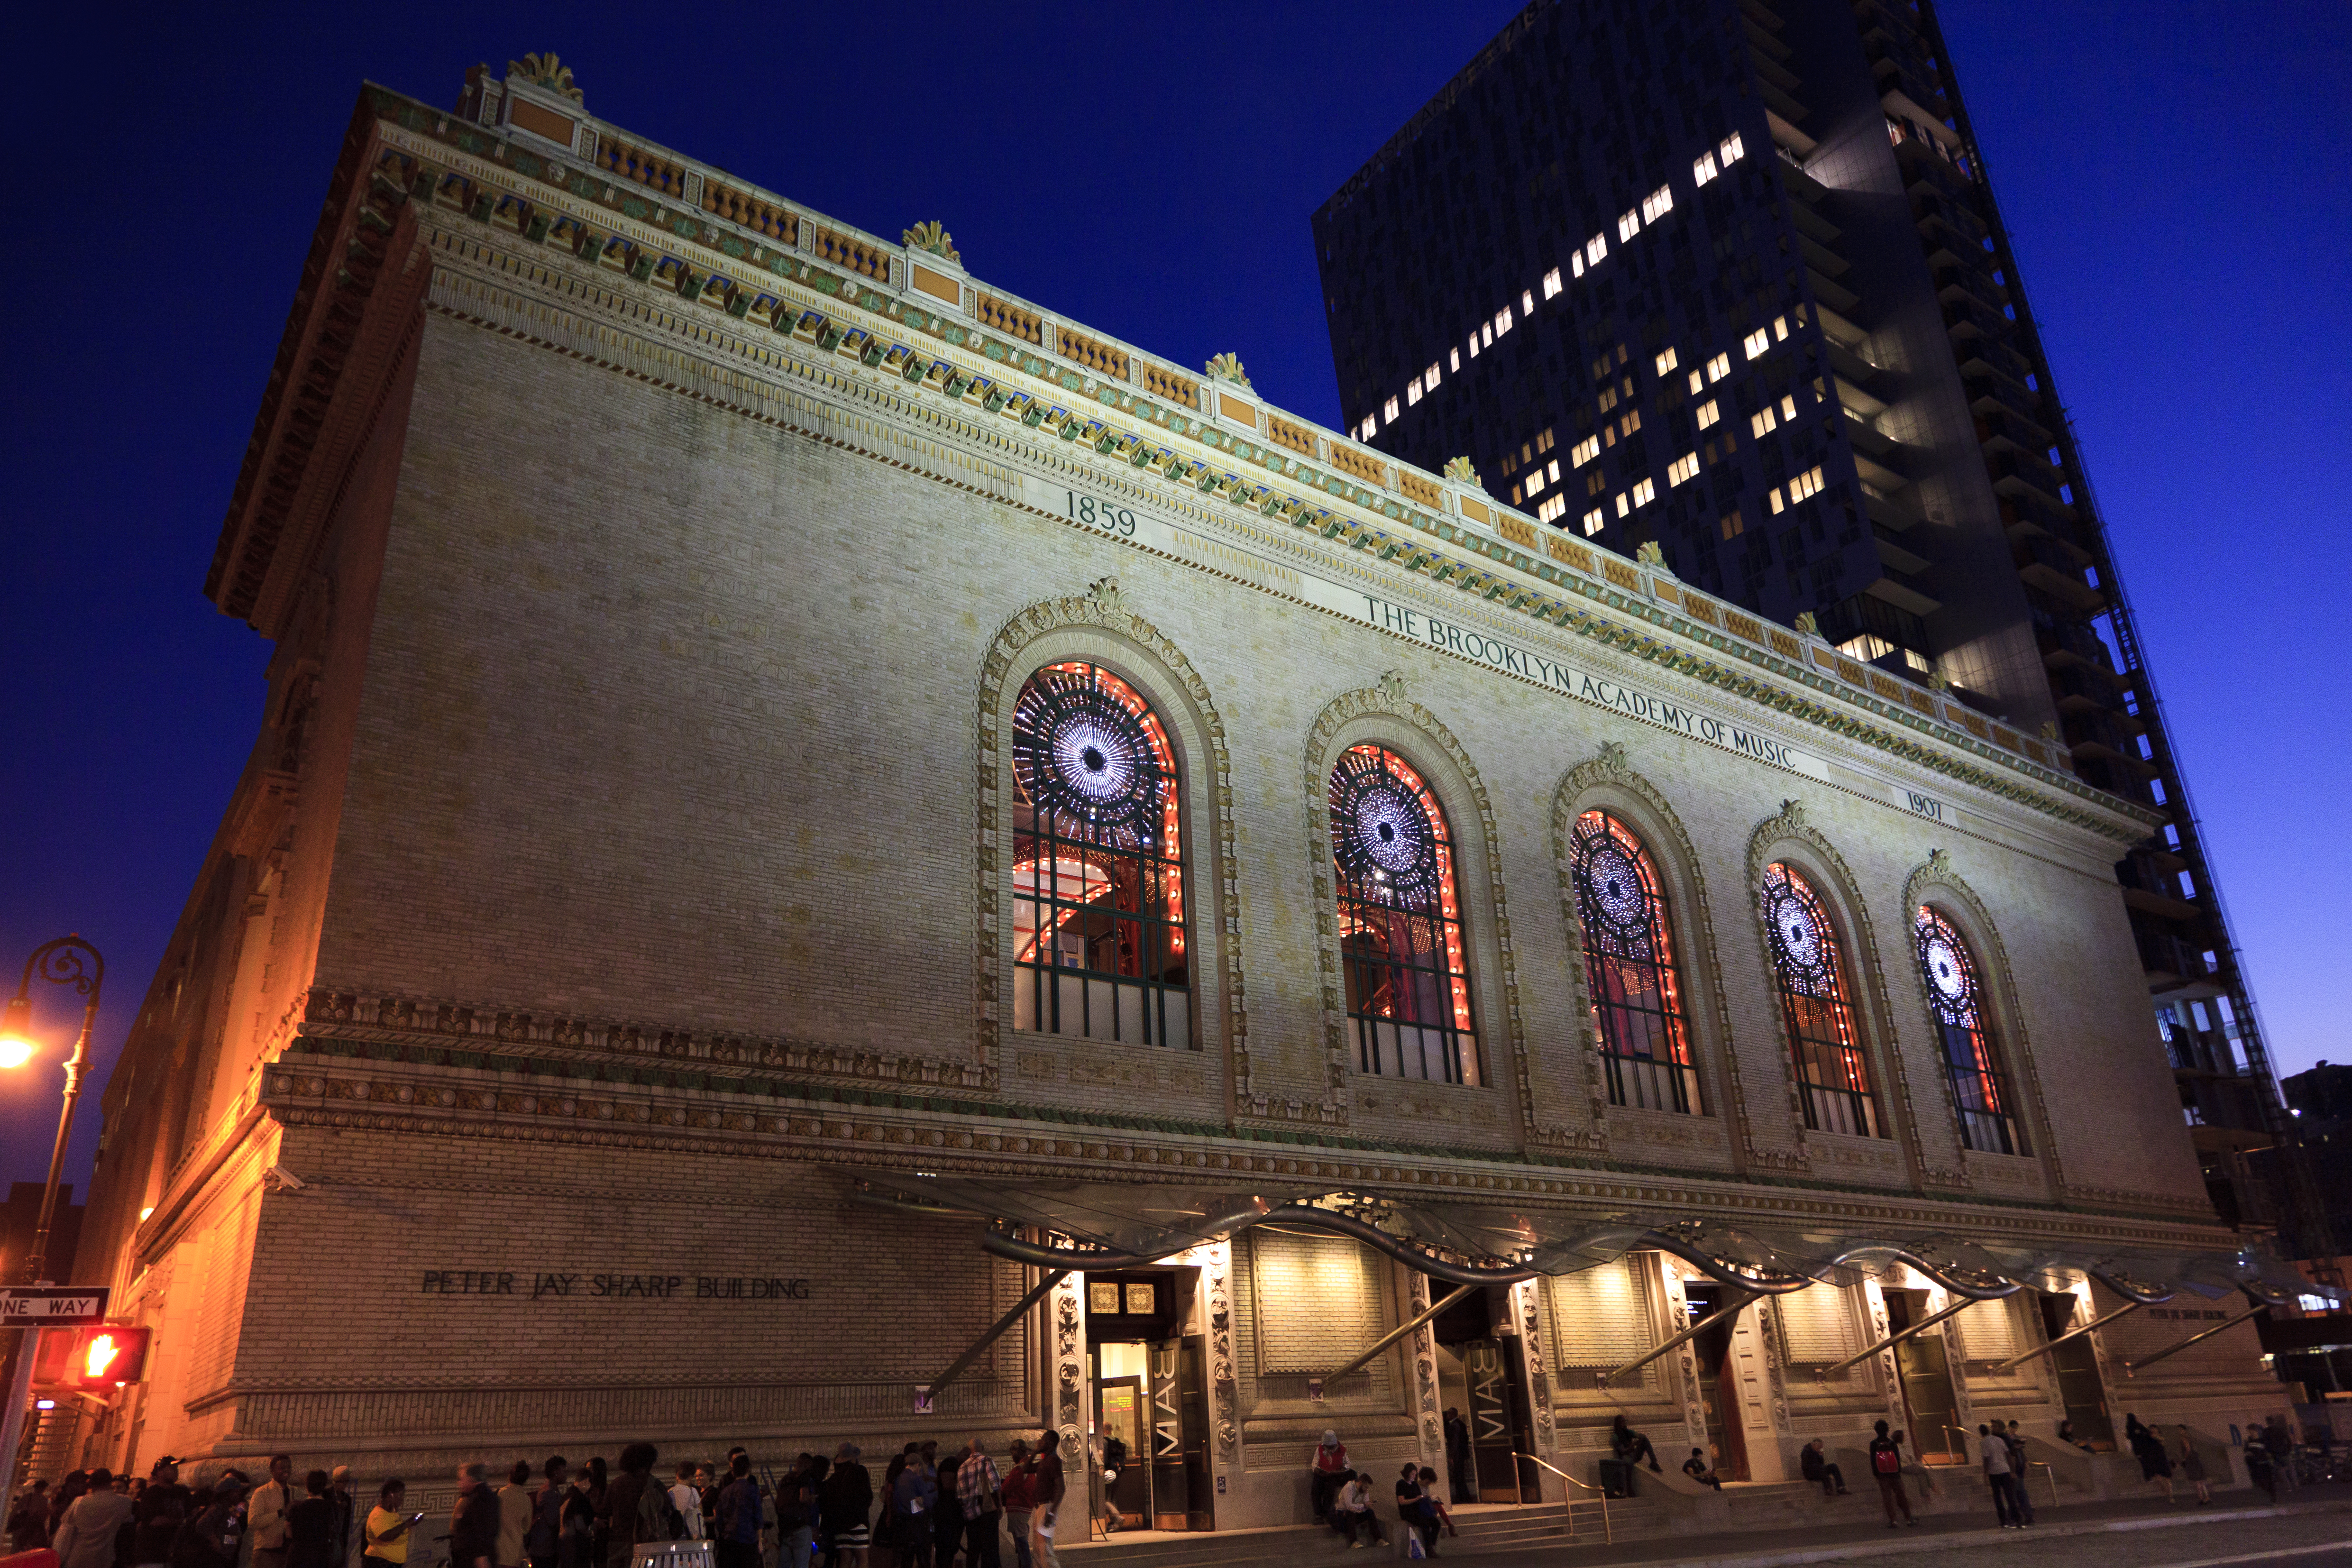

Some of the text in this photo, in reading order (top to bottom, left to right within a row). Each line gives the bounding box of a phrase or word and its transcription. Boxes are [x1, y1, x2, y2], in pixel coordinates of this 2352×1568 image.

[1066, 491, 1135, 536] 1859
[1363, 596, 1796, 768] THE BROOKLYN ACADEMY OF MUSIC
[1907, 791, 1941, 820] 1907
[421, 1269, 810, 1301] PETER JAY SHARP BUILDING
[0, 1299, 90, 1314] NE WAY
